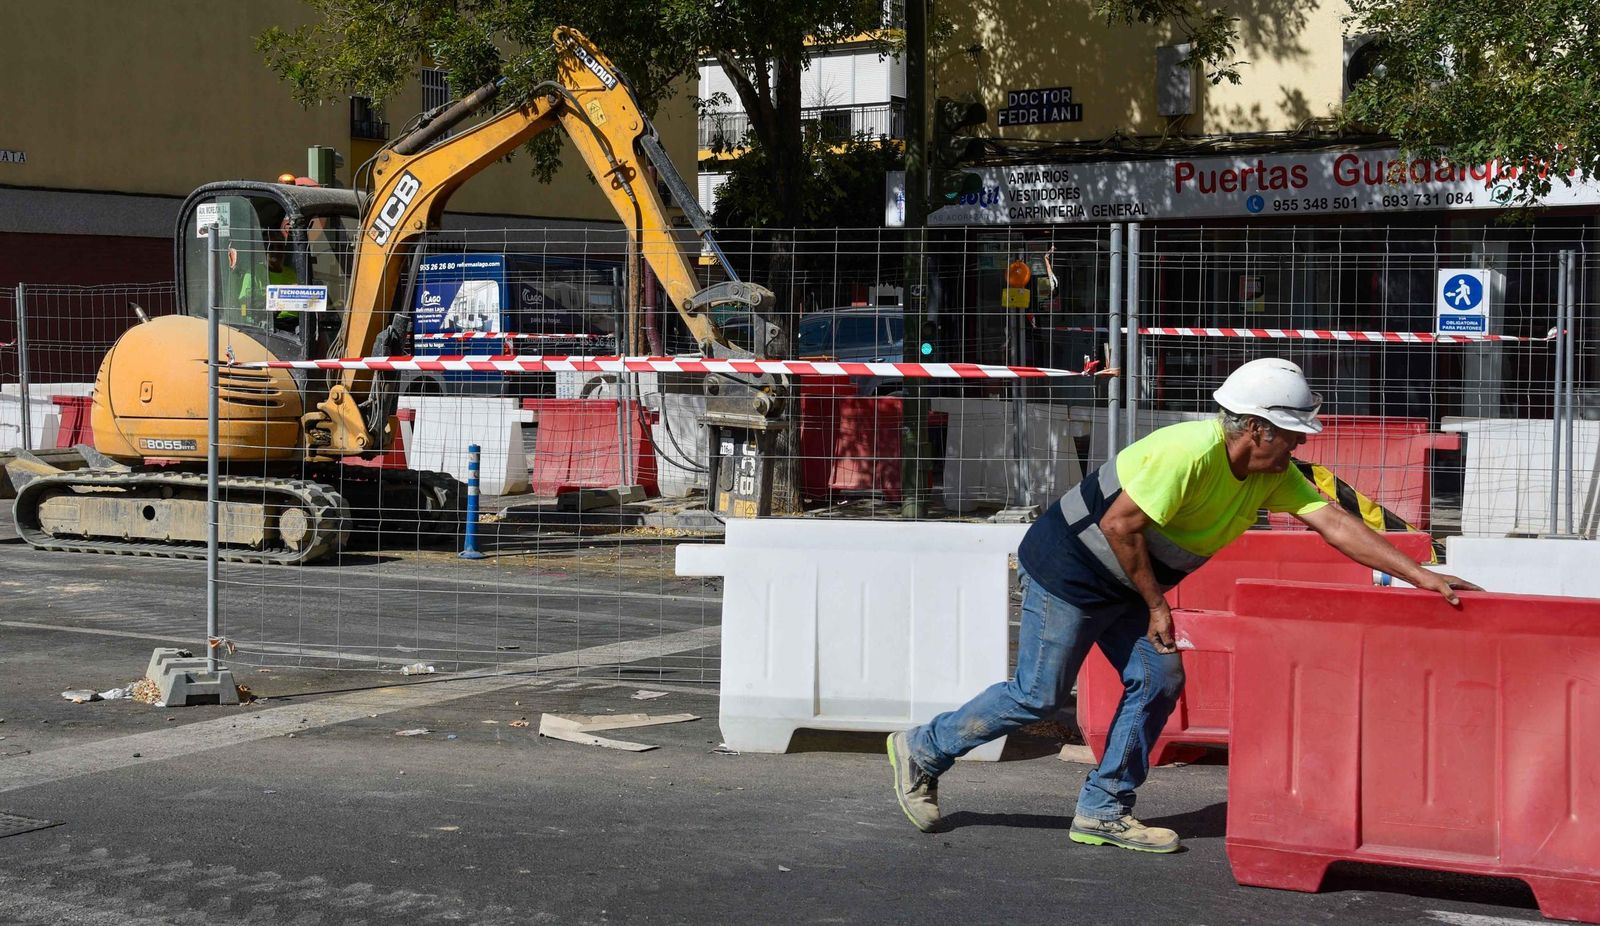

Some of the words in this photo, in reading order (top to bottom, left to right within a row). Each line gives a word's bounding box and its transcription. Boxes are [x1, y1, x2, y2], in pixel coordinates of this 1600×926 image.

[1009, 89, 1071, 107] DOCTOR
[998, 106, 1079, 125] FEDRIANI
[1008, 170, 1070, 185] ARMARIOS
[1175, 160, 1309, 194] Puertas
[1008, 187, 1081, 202] VESTIDORES
[1273, 199, 1299, 211] 955
[1303, 197, 1328, 210] 348
[1333, 196, 1358, 209] 501
[1382, 195, 1409, 207] 693
[1414, 193, 1440, 206] 731
[1446, 191, 1474, 205] 084
[375, 174, 420, 246] JCB
[1008, 204, 1085, 219] CARPINTERIA
[1091, 202, 1149, 218] GENERAL
[147, 439, 182, 450] 8055
